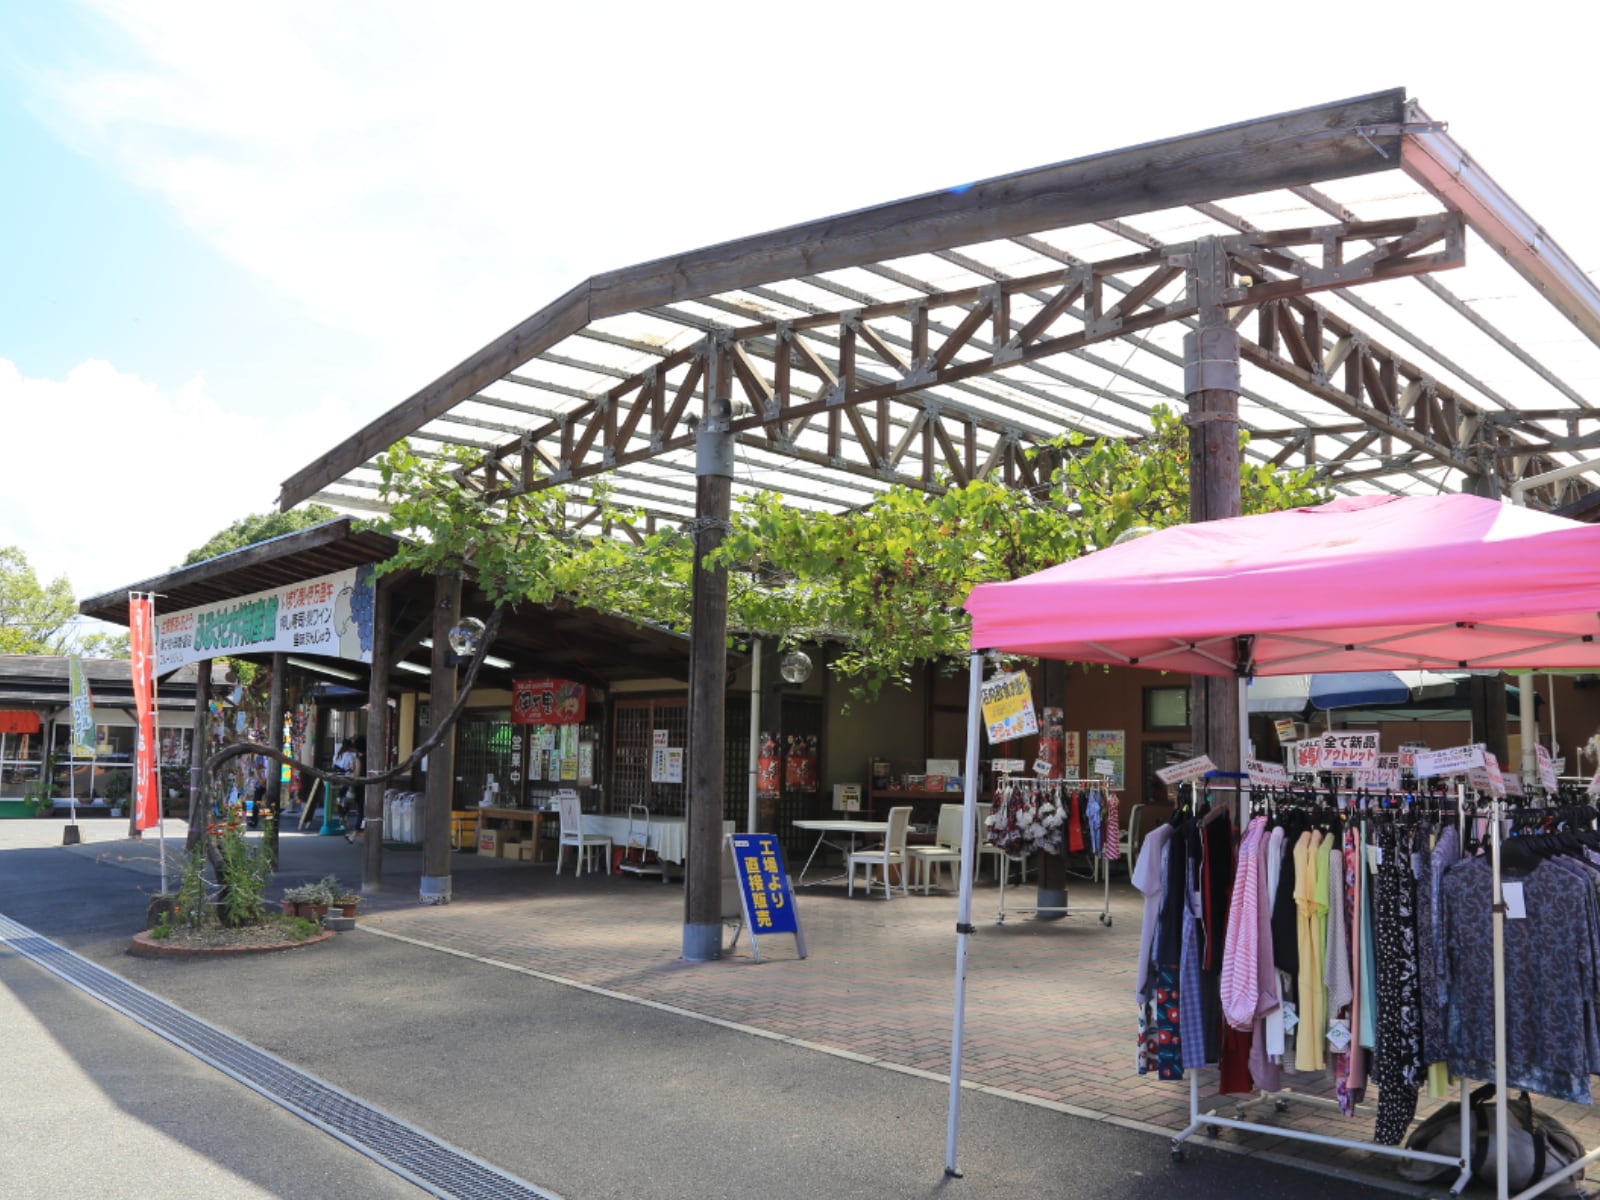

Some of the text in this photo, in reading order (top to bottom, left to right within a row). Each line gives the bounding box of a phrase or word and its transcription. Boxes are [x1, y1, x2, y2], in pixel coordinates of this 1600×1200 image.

[1323, 736, 1376, 749] 全て新品
[1324, 749, 1374, 761] アウトレット
[1358, 770, 1397, 782] アウトレット
[759, 840, 785, 909] 工場より
[744, 856, 773, 928] 直接販売
